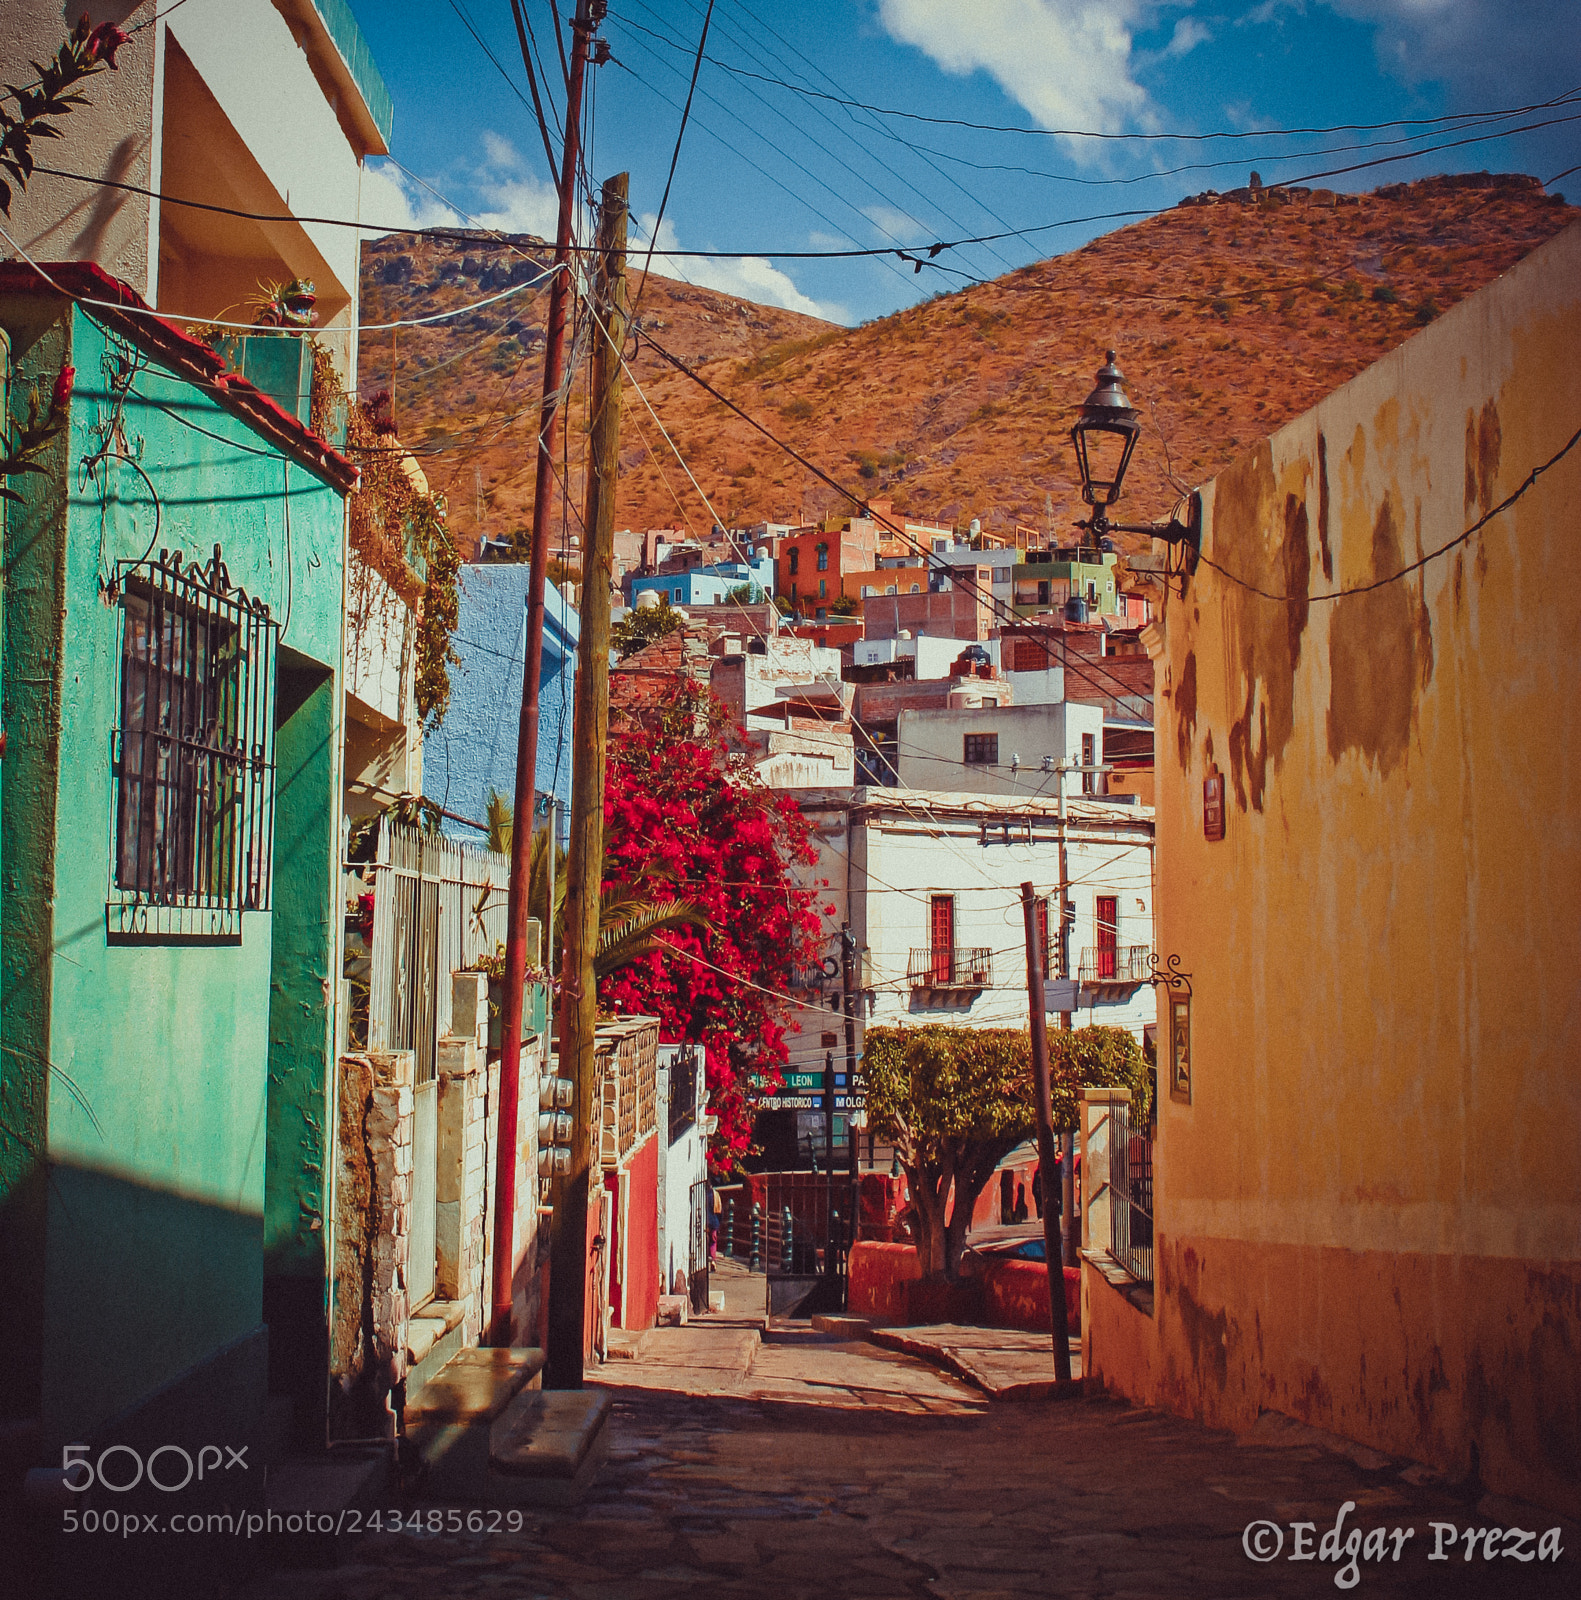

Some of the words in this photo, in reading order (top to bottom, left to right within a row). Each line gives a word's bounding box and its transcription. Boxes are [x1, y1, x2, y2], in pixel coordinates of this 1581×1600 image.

[791, 1075, 813, 1086] LEON
[852, 1075, 869, 1086] PA
[758, 1097, 781, 1108] CENTRO
[782, 1097, 812, 1108] HISTORICO
